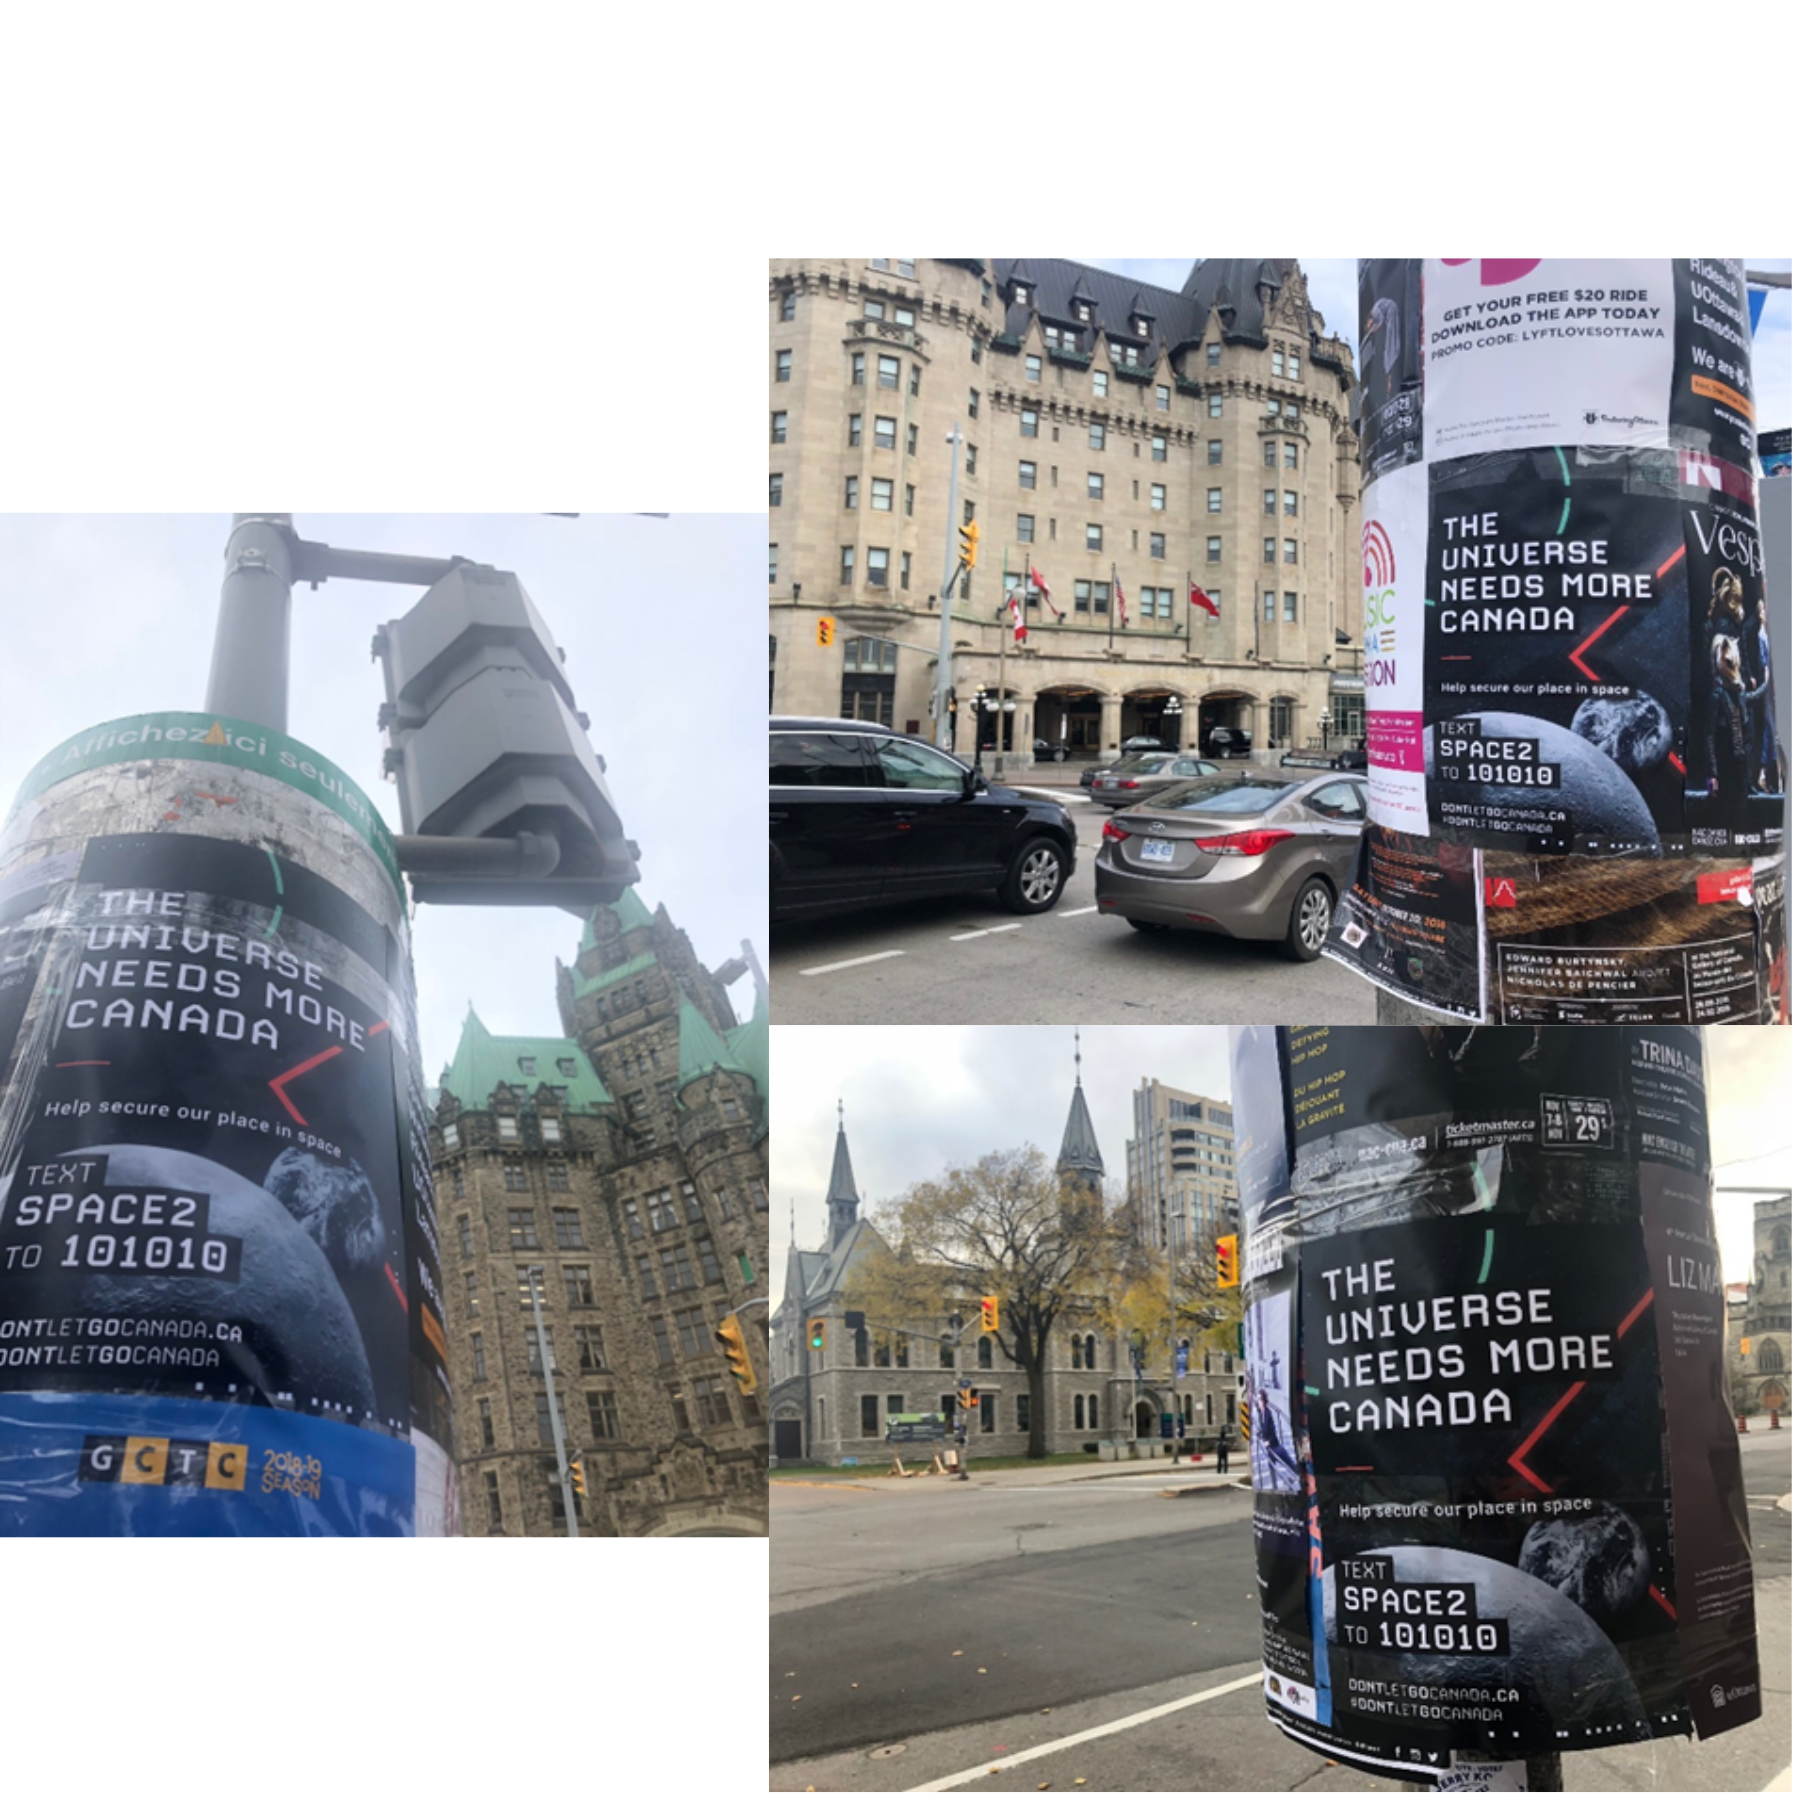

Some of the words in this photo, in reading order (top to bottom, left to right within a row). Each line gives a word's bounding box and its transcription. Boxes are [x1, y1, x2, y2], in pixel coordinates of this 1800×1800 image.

[1443, 303, 1473, 323] GET
[1476, 294, 1523, 315] YOUR
[1526, 289, 1569, 306] FREE
[1574, 288, 1605, 302] $20
[1610, 288, 1648, 302] RIDE
[1431, 313, 1522, 345] DOWNLOAD
[1528, 308, 1560, 323] THE
[1564, 306, 1598, 321] APP
[1602, 307, 1661, 320] TODAY
[1430, 341, 1473, 362] PROMO
[1476, 332, 1519, 349] CODE:
[1521, 325, 1665, 342] LYFTLOVESOTTAWA
[1691, 345, 1716, 371] We
[1443, 511, 1499, 540] THE
[1441, 539, 1609, 571] UNIVERSE
[1440, 572, 1545, 602] NEEDS
[1561, 573, 1653, 599] MORE
[1440, 606, 1575, 633] CANADA
[1440, 682, 1467, 694] Help
[1470, 682, 1510, 693] secure
[1513, 684, 1534, 693] our
[1537, 683, 1573, 696] place
[1576, 683, 1589, 694] in
[1592, 685, 1630, 697] space
[1439, 721, 1476, 735] TEXT
[61, 722, 209, 768] Affichez
[1440, 739, 1533, 761] SPACE2
[1441, 766, 1459, 780] TO
[1467, 762, 1553, 785] 101010
[98, 891, 185, 917] THE
[86, 924, 324, 991] UNIVERSE
[1505, 952, 1554, 966] EDWARD
[1506, 964, 1562, 978] JENNIFER
[1506, 975, 1565, 989] NICHOLAS
[1568, 980, 1583, 991] DE
[1587, 980, 1637, 991] PENCIER
[75, 959, 241, 999] NEEDS
[265, 983, 366, 1052] MORE
[65, 998, 279, 1051] CANADA
[1290, 1052, 1307, 1066] HIP
[1307, 1043, 1329, 1059] HOP
[1639, 1038, 1685, 1071] TRINA
[1293, 1085, 1307, 1098] DU
[1306, 1078, 1323, 1092] HIP
[1324, 1069, 1347, 1086] HOP
[44, 1098, 92, 1118] Help
[98, 1101, 170, 1118] secure
[177, 1105, 211, 1122] our
[217, 1110, 270, 1134] place
[275, 1120, 292, 1139] in
[297, 1129, 343, 1160] space
[1445, 1119, 1536, 1138] ticketmaster.ca
[1575, 1114, 1600, 1141] 29
[26, 1161, 97, 1188] TEXT
[15, 1193, 199, 1229] SPACE2
[5, 1242, 43, 1270] TO
[60, 1233, 229, 1274] 101010
[1321, 1257, 1396, 1301] THE
[1667, 1254, 1699, 1290] LIZ
[0, 1318, 243, 1343] ONTLETGOCANADA.CA
[1324, 1288, 1553, 1346] UNIVERSE
[1326, 1344, 1466, 1390] NEEDS
[1489, 1334, 1614, 1375] MORE
[1328, 1387, 1512, 1433] CANADA
[262, 1448, 323, 1481] 2018-19
[260, 1471, 322, 1502] SEASON
[1338, 1503, 1371, 1520] Help
[1375, 1504, 1429, 1518] secure
[1433, 1504, 1462, 1518] our
[1467, 1501, 1516, 1519] place
[1520, 1499, 1537, 1514] in
[1542, 1497, 1593, 1514] space
[1341, 1559, 1387, 1581] TEXT
[1343, 1585, 1468, 1617] SPACE2
[1344, 1624, 1369, 1645] TO
[1379, 1621, 1498, 1652] 101010
[1348, 1678, 1521, 1703] DONTLETGOCANADA.CA
[1350, 1697, 1504, 1722] #DONTLETGOCANADA
